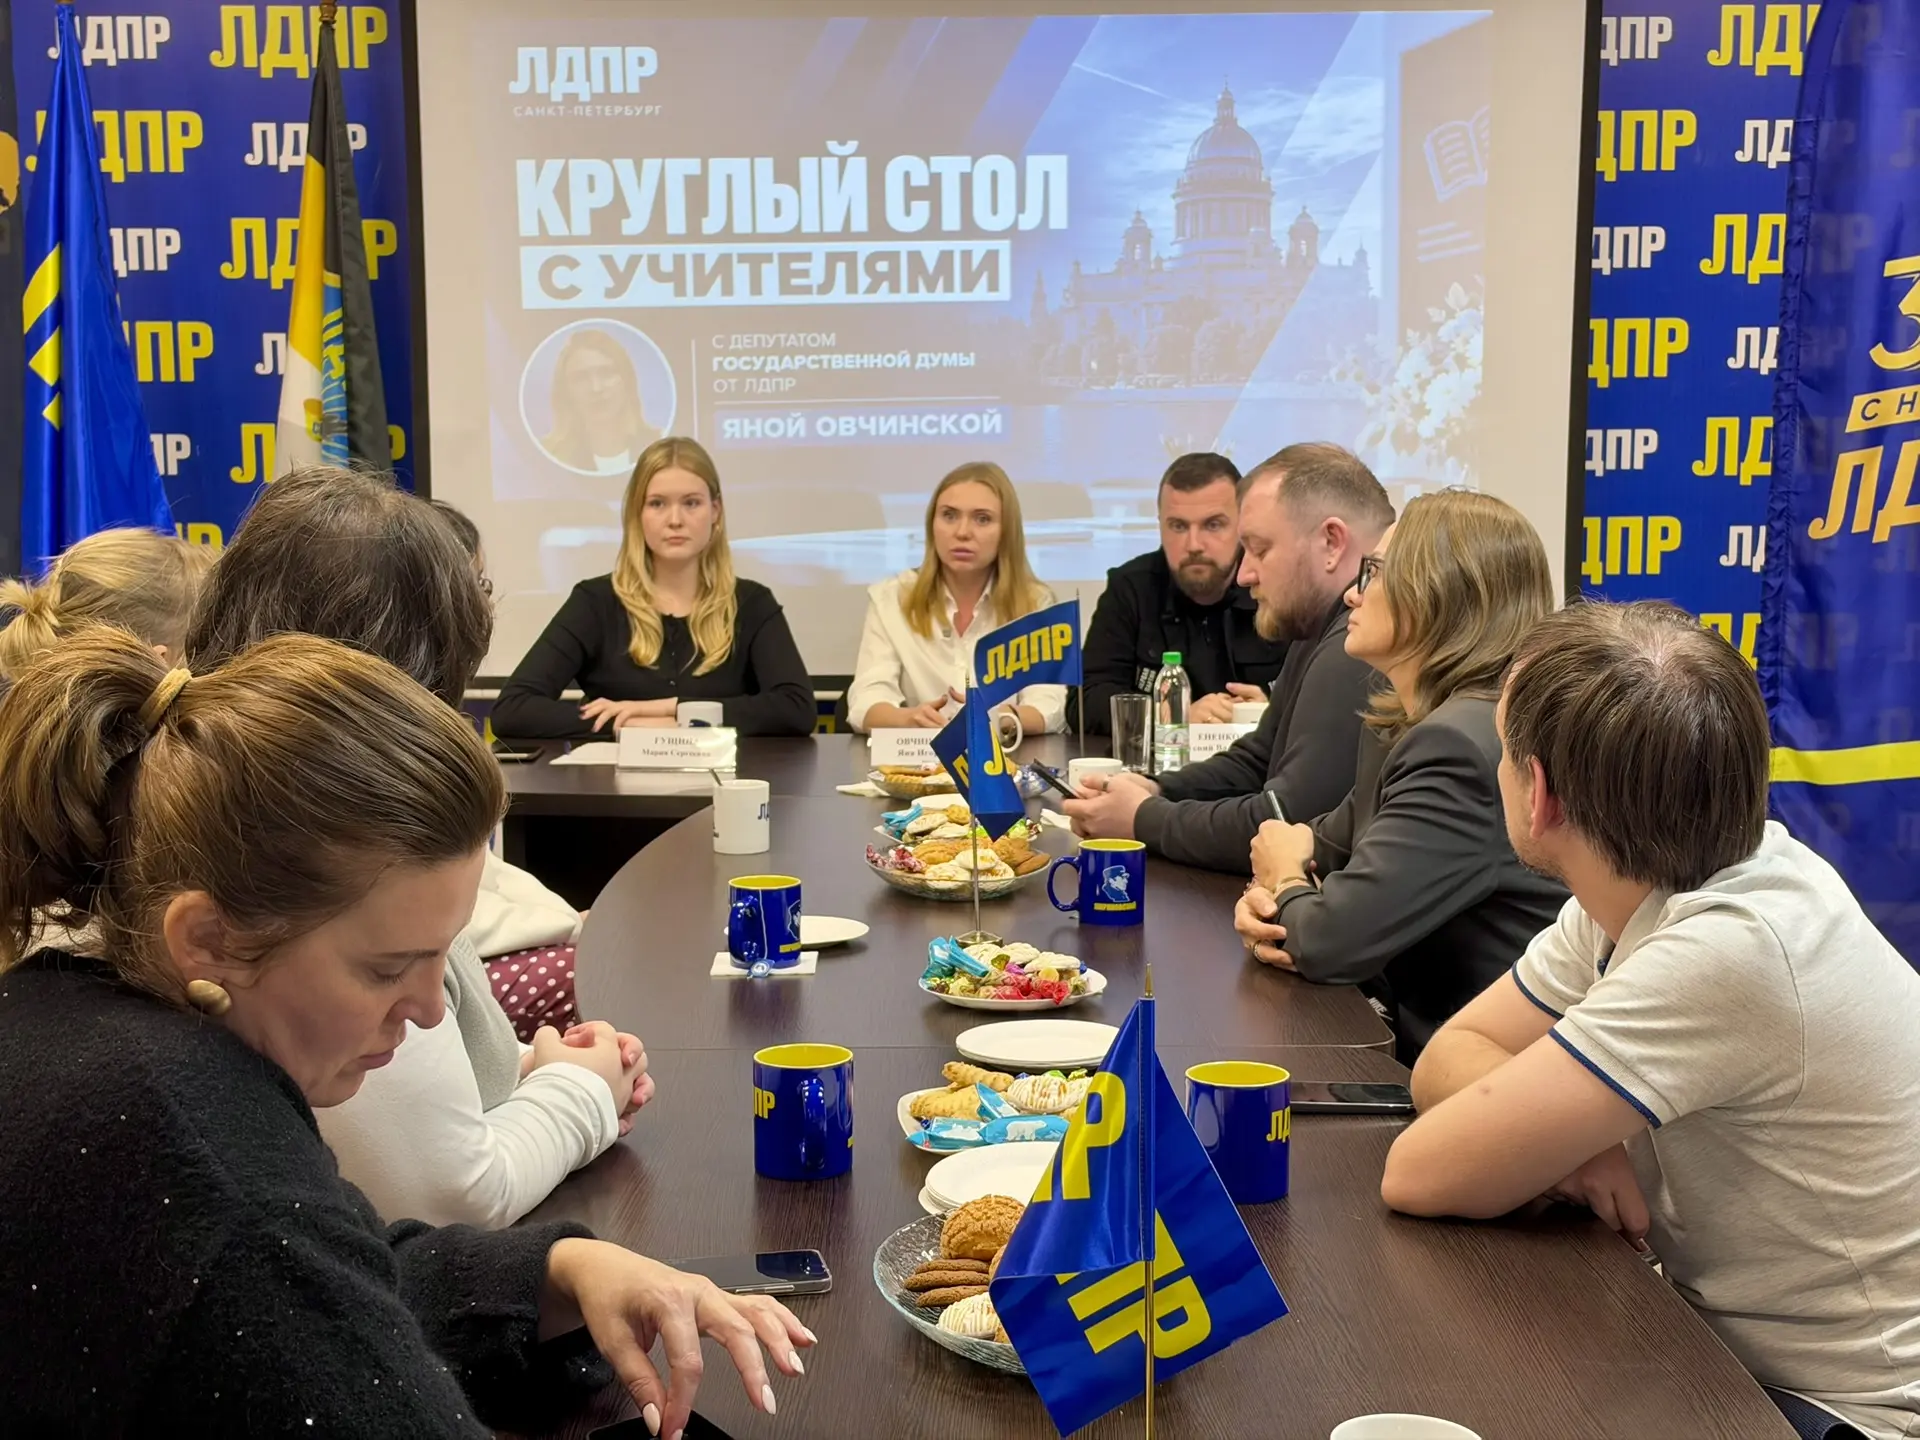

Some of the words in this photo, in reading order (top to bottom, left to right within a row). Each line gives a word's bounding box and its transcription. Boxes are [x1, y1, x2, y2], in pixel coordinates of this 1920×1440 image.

[1600, 17, 1673, 66] ДПР
[1707, 4, 1822, 76] ЛД
[509, 46, 658, 102] ЛДПР
[513, 105, 662, 117] САНКТ-ПЕТЕРБУРГ
[25, 110, 203, 182] ДПР
[244, 122, 366, 172] ЛДР
[1596, 109, 1697, 182] ДПР
[1735, 119, 1794, 168] ЛД
[516, 140, 868, 237] КРУГЛЫЙ
[884, 154, 1069, 231] СТОЛ
[220, 217, 397, 289] ЛДР
[537, 254, 583, 300] С
[597, 248, 1001, 299] УЧИТЕЛЯМИ
[1592, 226, 1666, 275] ДПР
[1700, 213, 1787, 284] ЛД
[712, 334, 724, 348] С
[729, 332, 836, 350] ДЕПУТАТОМ
[712, 351, 911, 372] ГОСУДАРСТВЕННОЙ
[915, 352, 976, 370] ДУМЫ
[1588, 317, 1689, 388] ДПР
[713, 379, 738, 393] ОТ
[744, 378, 796, 394] ЛДПР
[722, 412, 805, 439] ЯНОЙ
[816, 408, 1002, 436] ОВЧИНСКОЙ
[1585, 428, 1658, 477] ДПР
[1692, 416, 1774, 486] ЛД
[1808, 439, 1920, 544] ЛД
[1582, 516, 1681, 585] ДПР
[983, 623, 1073, 685] ЛДПР
[753, 1086, 776, 1119] ПР
[1266, 1105, 1291, 1143] ЛД
